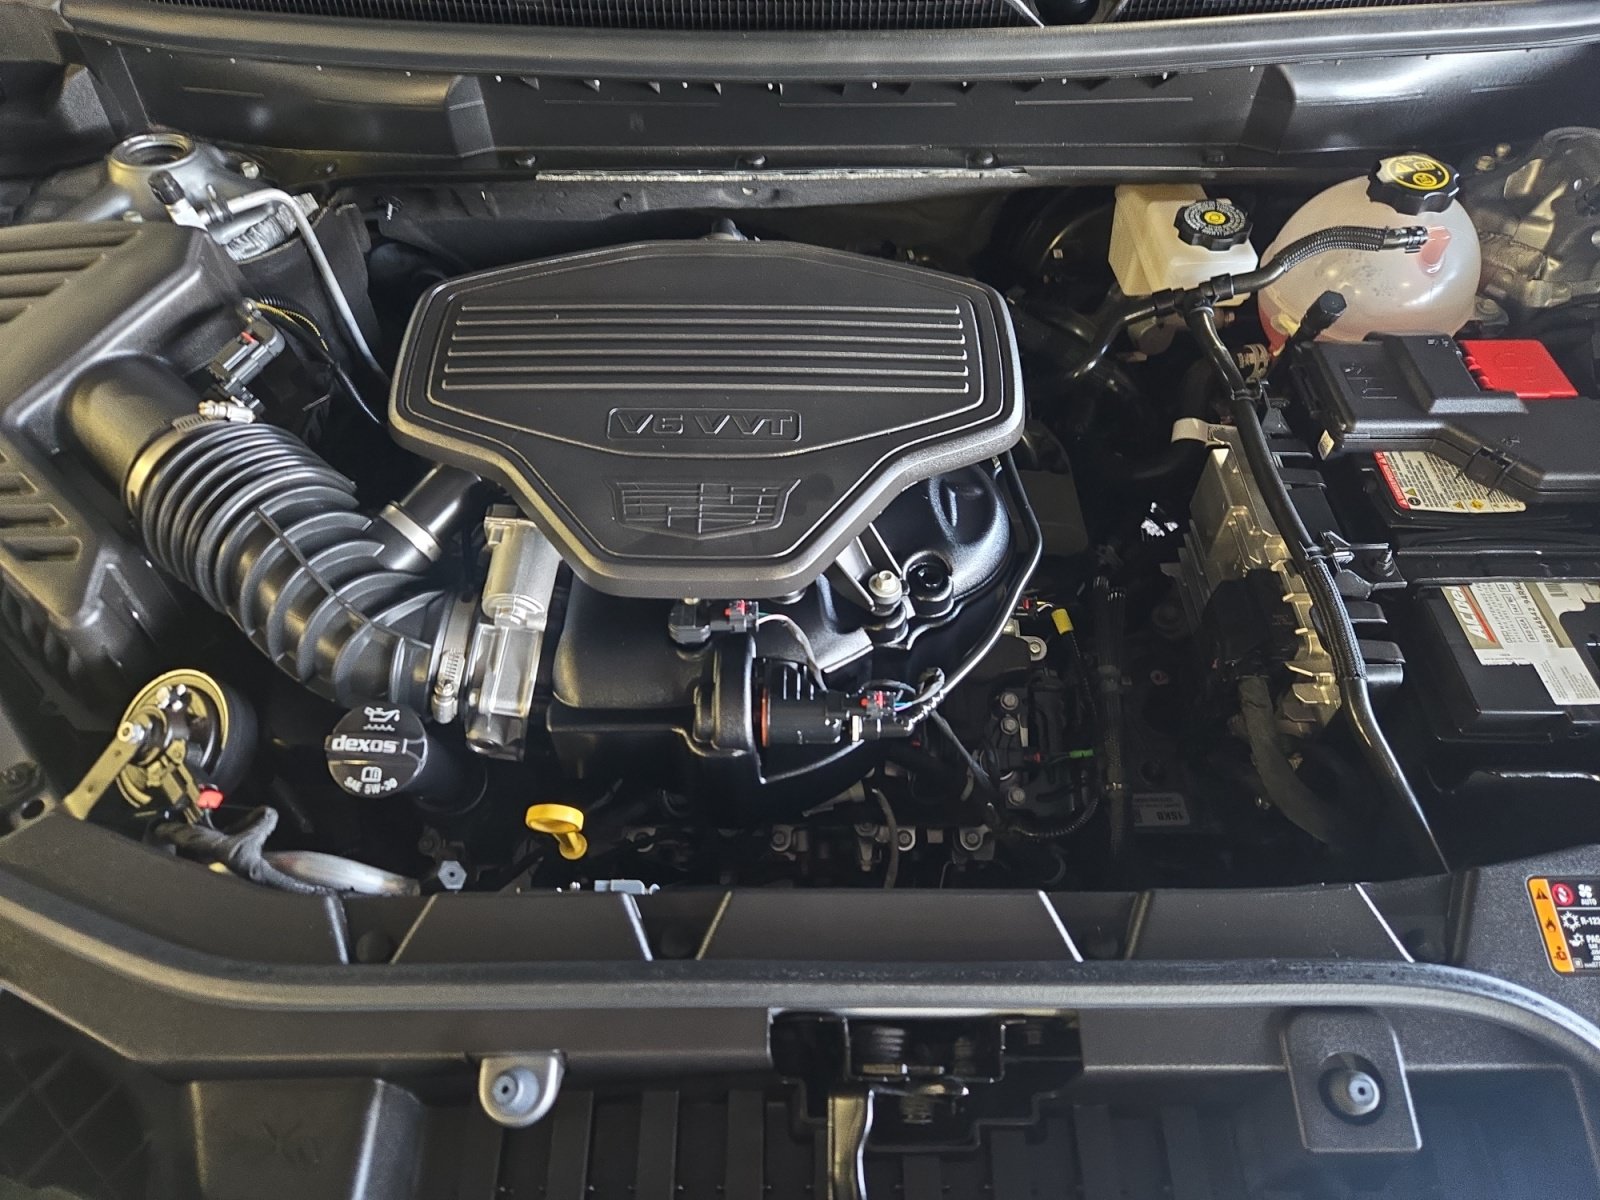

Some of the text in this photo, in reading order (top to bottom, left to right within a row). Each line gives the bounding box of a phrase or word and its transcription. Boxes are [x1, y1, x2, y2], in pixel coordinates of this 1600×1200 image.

[617, 413, 793, 436] V6 VVT
[1518, 618, 1529, 629] CCA
[1526, 607, 1554, 642] 88864542
[331, 735, 400, 754] dexos
[343, 776, 398, 795] SAE 5W-30
[1581, 898, 1597, 906] AUTO
